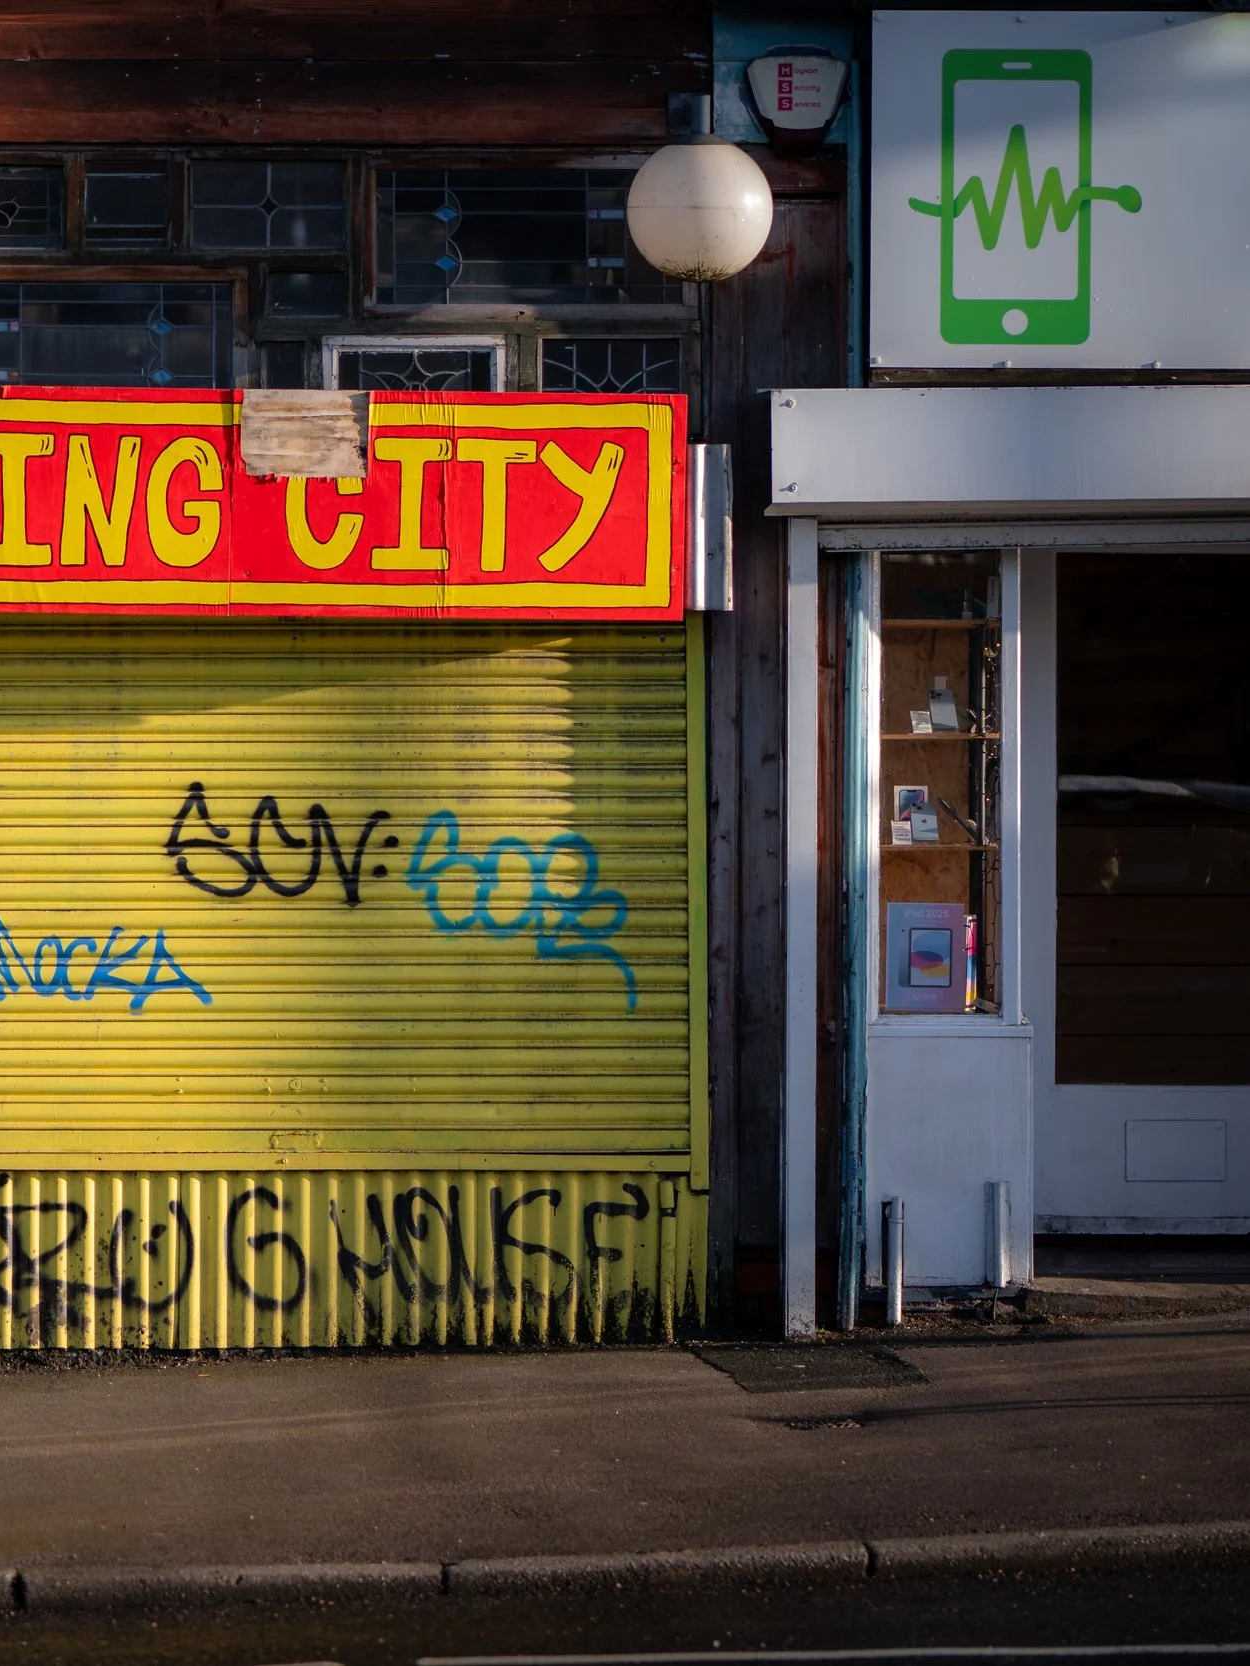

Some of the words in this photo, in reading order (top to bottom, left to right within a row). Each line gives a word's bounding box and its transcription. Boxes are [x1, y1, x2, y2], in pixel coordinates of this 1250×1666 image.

[781, 82, 821, 92] Security
[781, 99, 821, 108] Services
[284, 437, 626, 574] CITY
[903, 908, 924, 918] iPad
[926, 908, 950, 918] 2025
